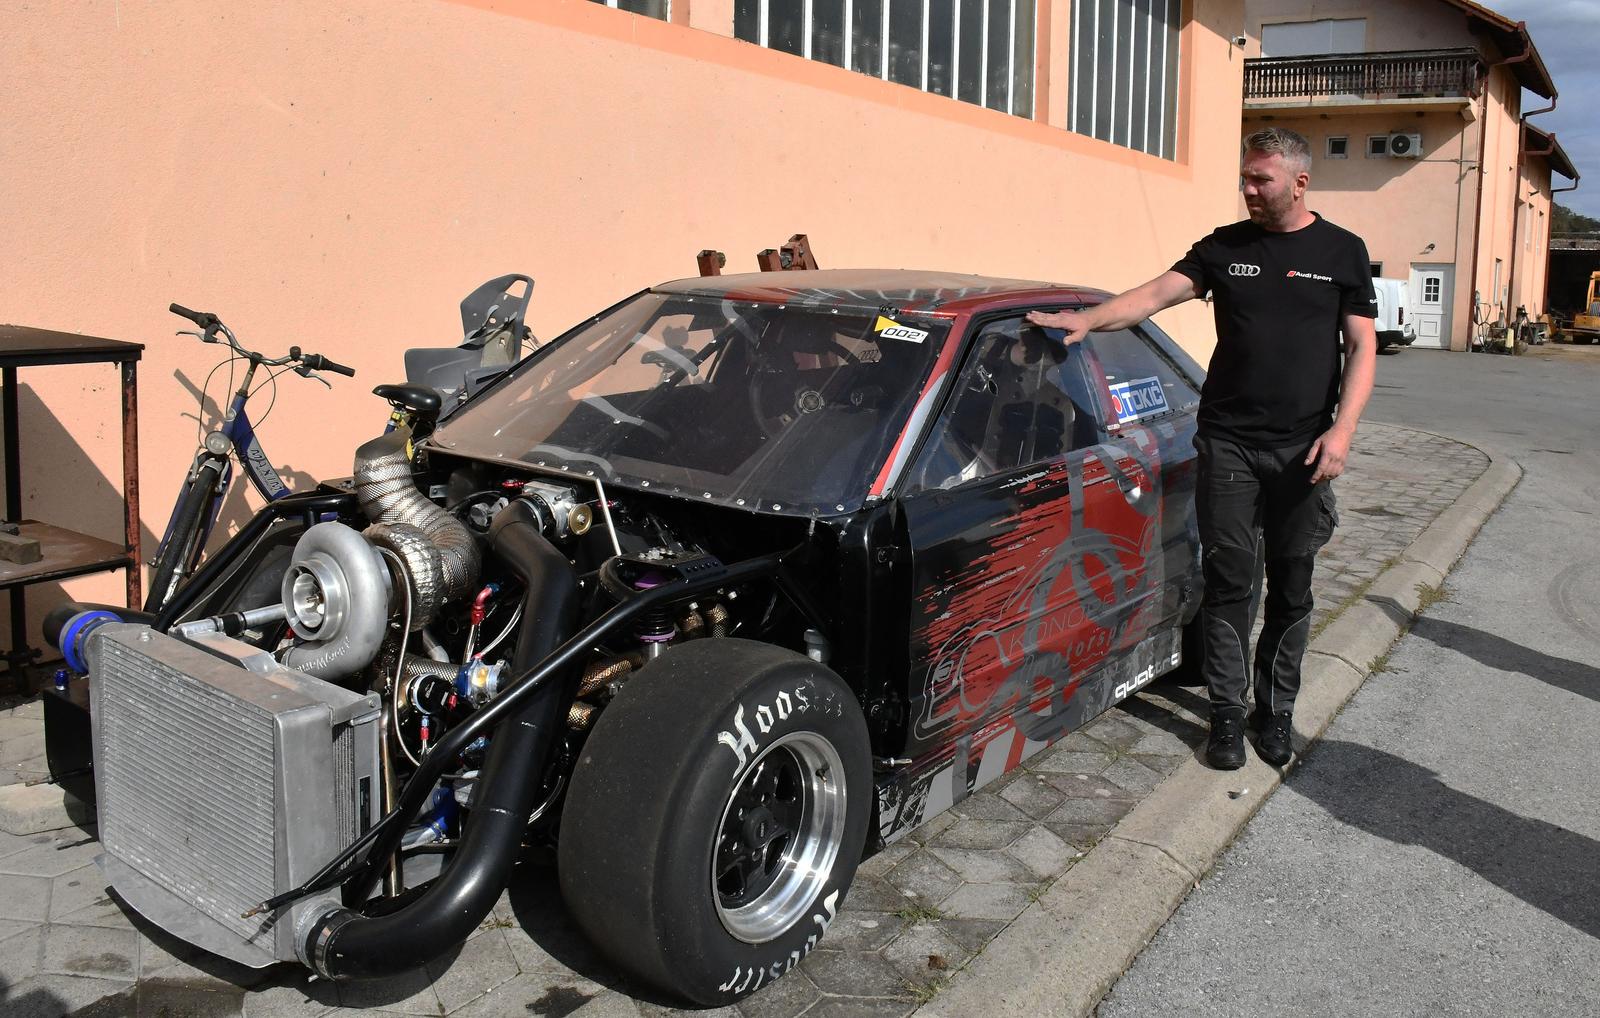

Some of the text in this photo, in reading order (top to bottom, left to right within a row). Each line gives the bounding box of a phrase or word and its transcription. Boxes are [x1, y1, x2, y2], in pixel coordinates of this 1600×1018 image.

[1295, 271, 1332, 283] Audi Sport
[1120, 381, 1163, 412] TOKIĆ
[717, 675, 843, 780] Hoos
